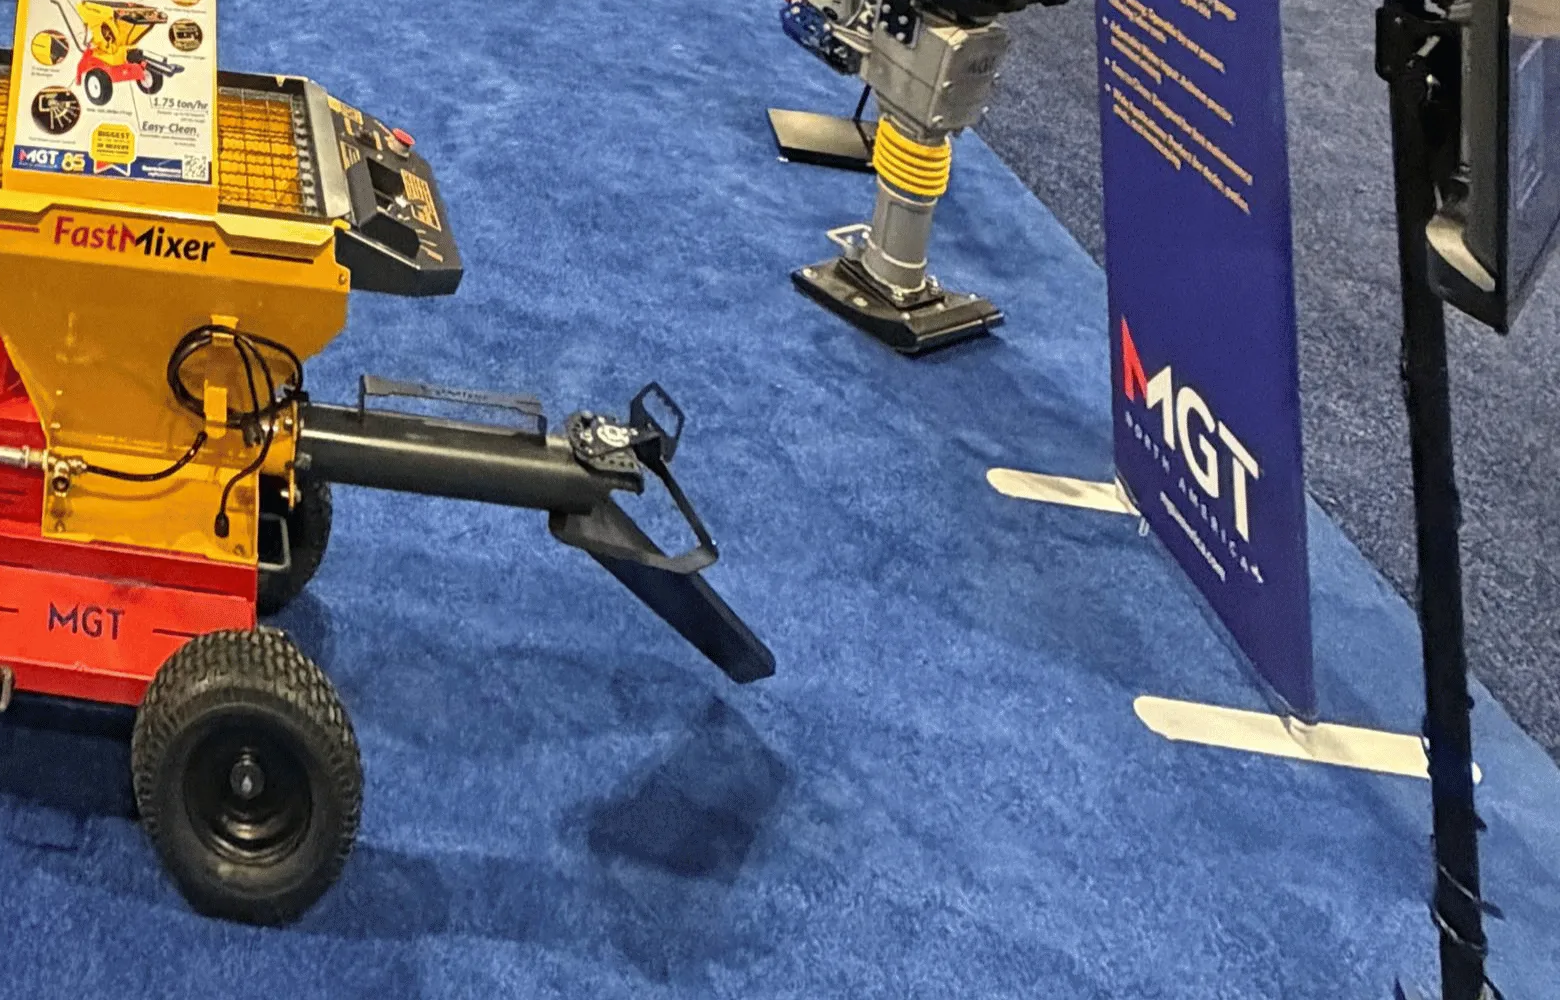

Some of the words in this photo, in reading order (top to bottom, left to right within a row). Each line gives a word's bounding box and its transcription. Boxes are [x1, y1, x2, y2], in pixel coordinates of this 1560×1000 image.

[18, 148, 60, 165] MGT
[53, 215, 216, 264] FastMixer
[1122, 314, 1260, 543] MGT
[48, 601, 126, 641] MGT
